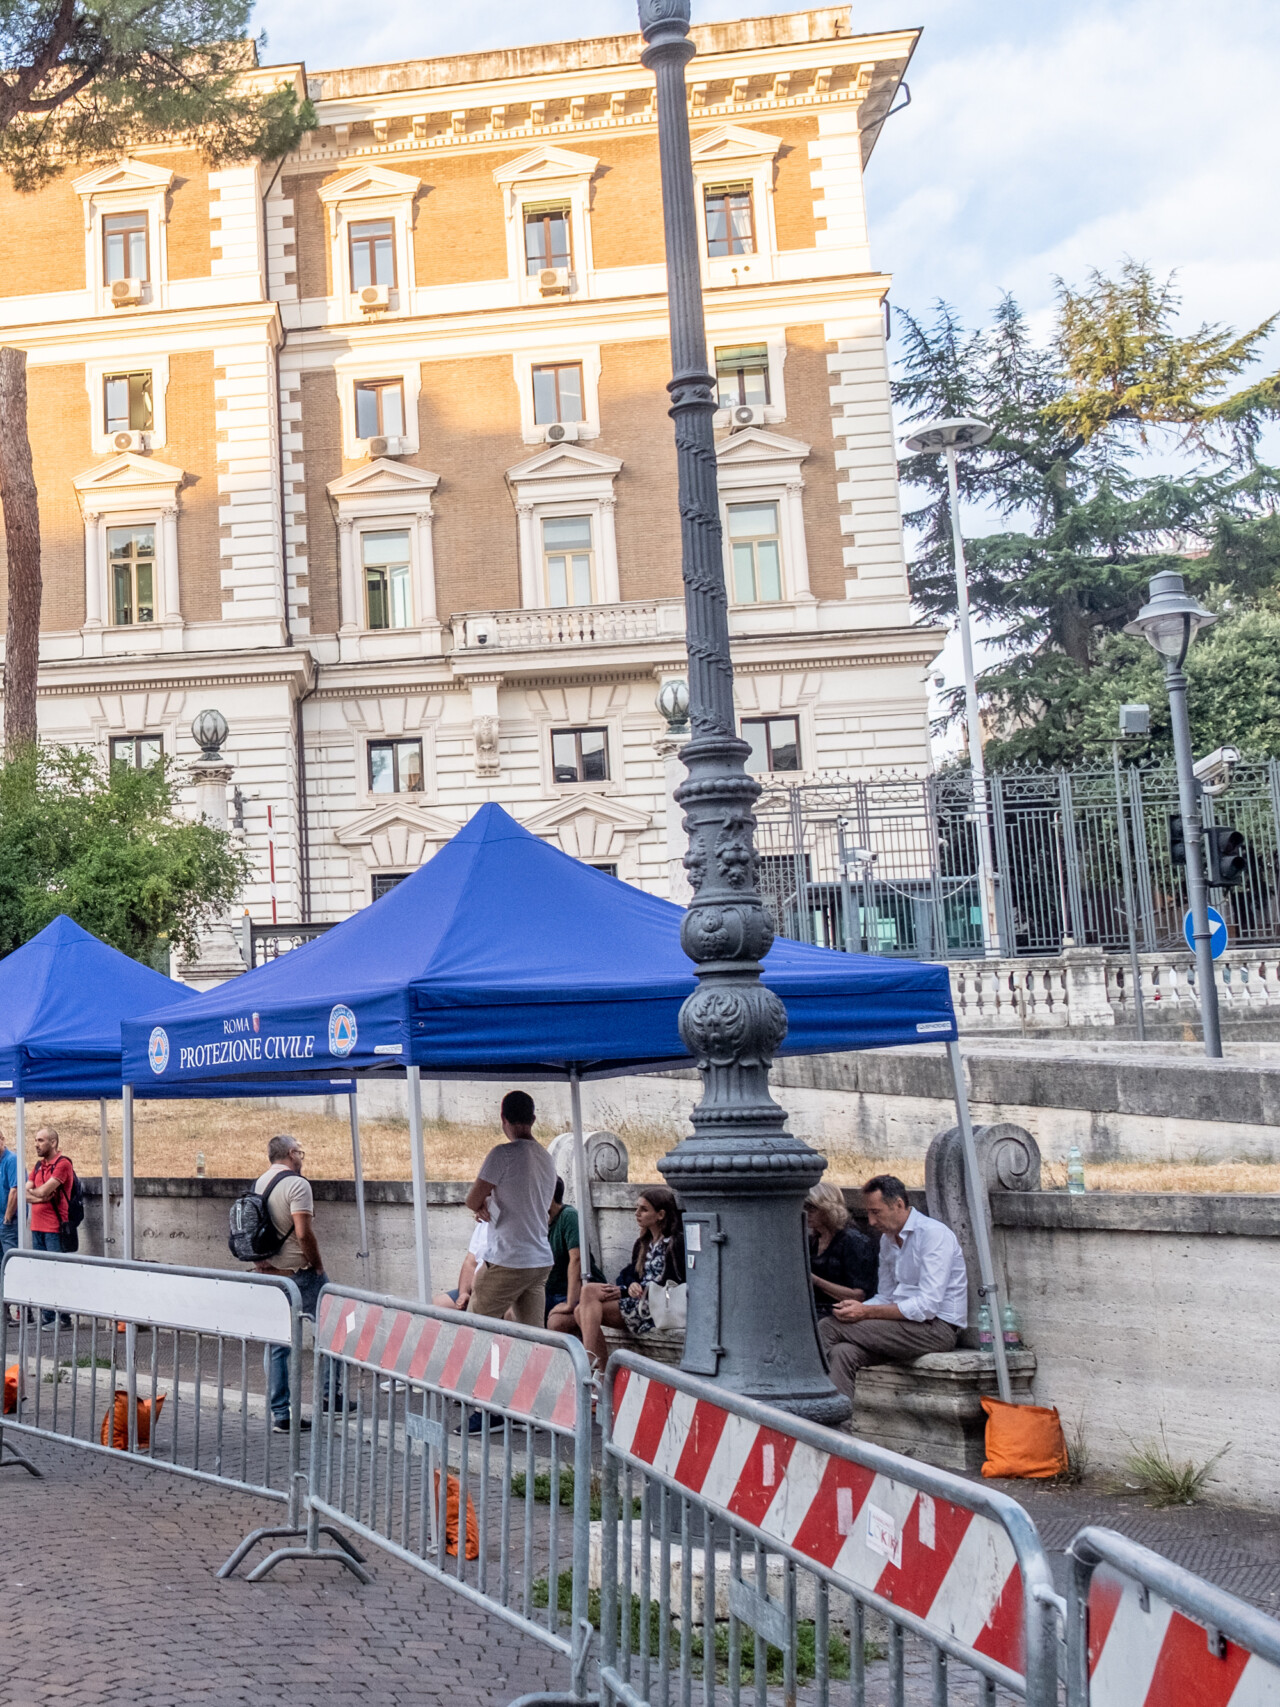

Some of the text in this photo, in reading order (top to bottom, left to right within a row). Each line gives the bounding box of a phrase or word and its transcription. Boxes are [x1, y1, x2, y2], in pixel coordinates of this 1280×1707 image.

[223, 1017, 250, 1035] ROMA
[180, 1038, 262, 1069] PROTEZIONE
[264, 1035, 315, 1060] CIVILE
